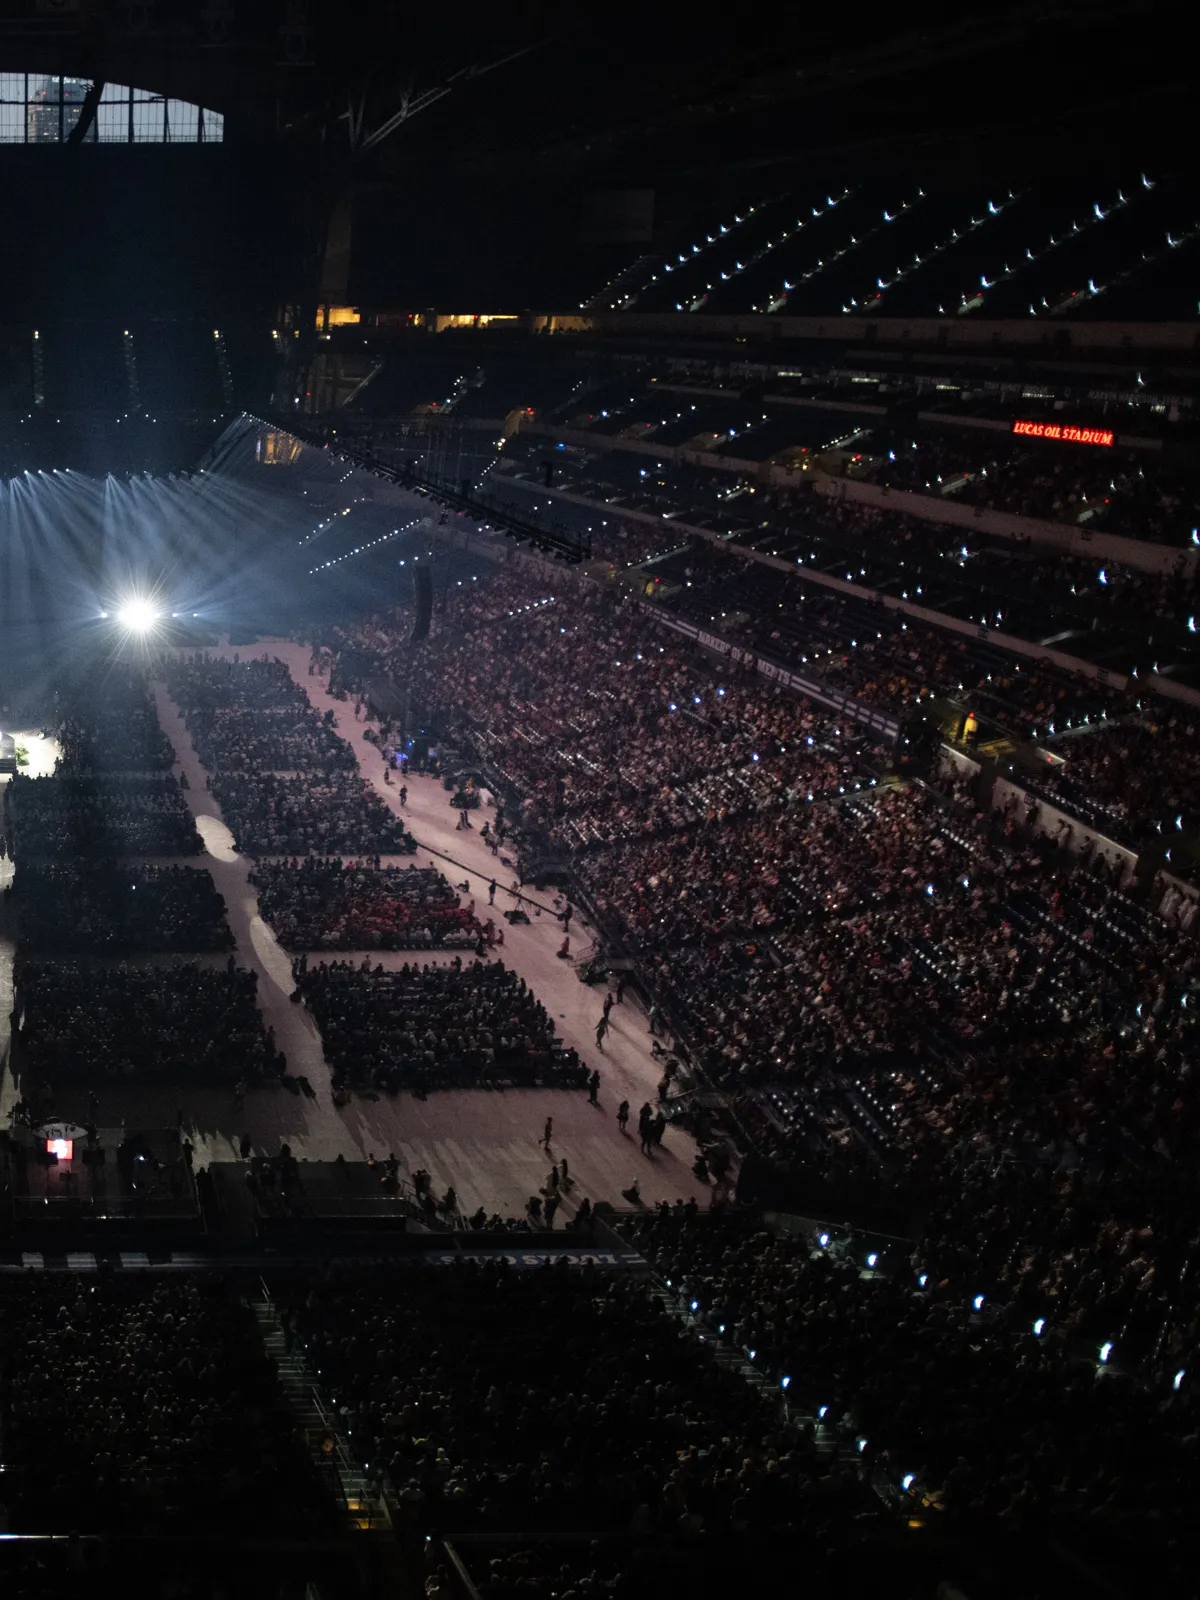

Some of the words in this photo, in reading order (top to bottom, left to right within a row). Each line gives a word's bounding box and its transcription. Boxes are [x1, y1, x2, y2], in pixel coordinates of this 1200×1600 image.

[1013, 421, 1044, 436] LUCAS
[1044, 426, 1061, 439] OIL
[1062, 428, 1113, 445] STADIUM
